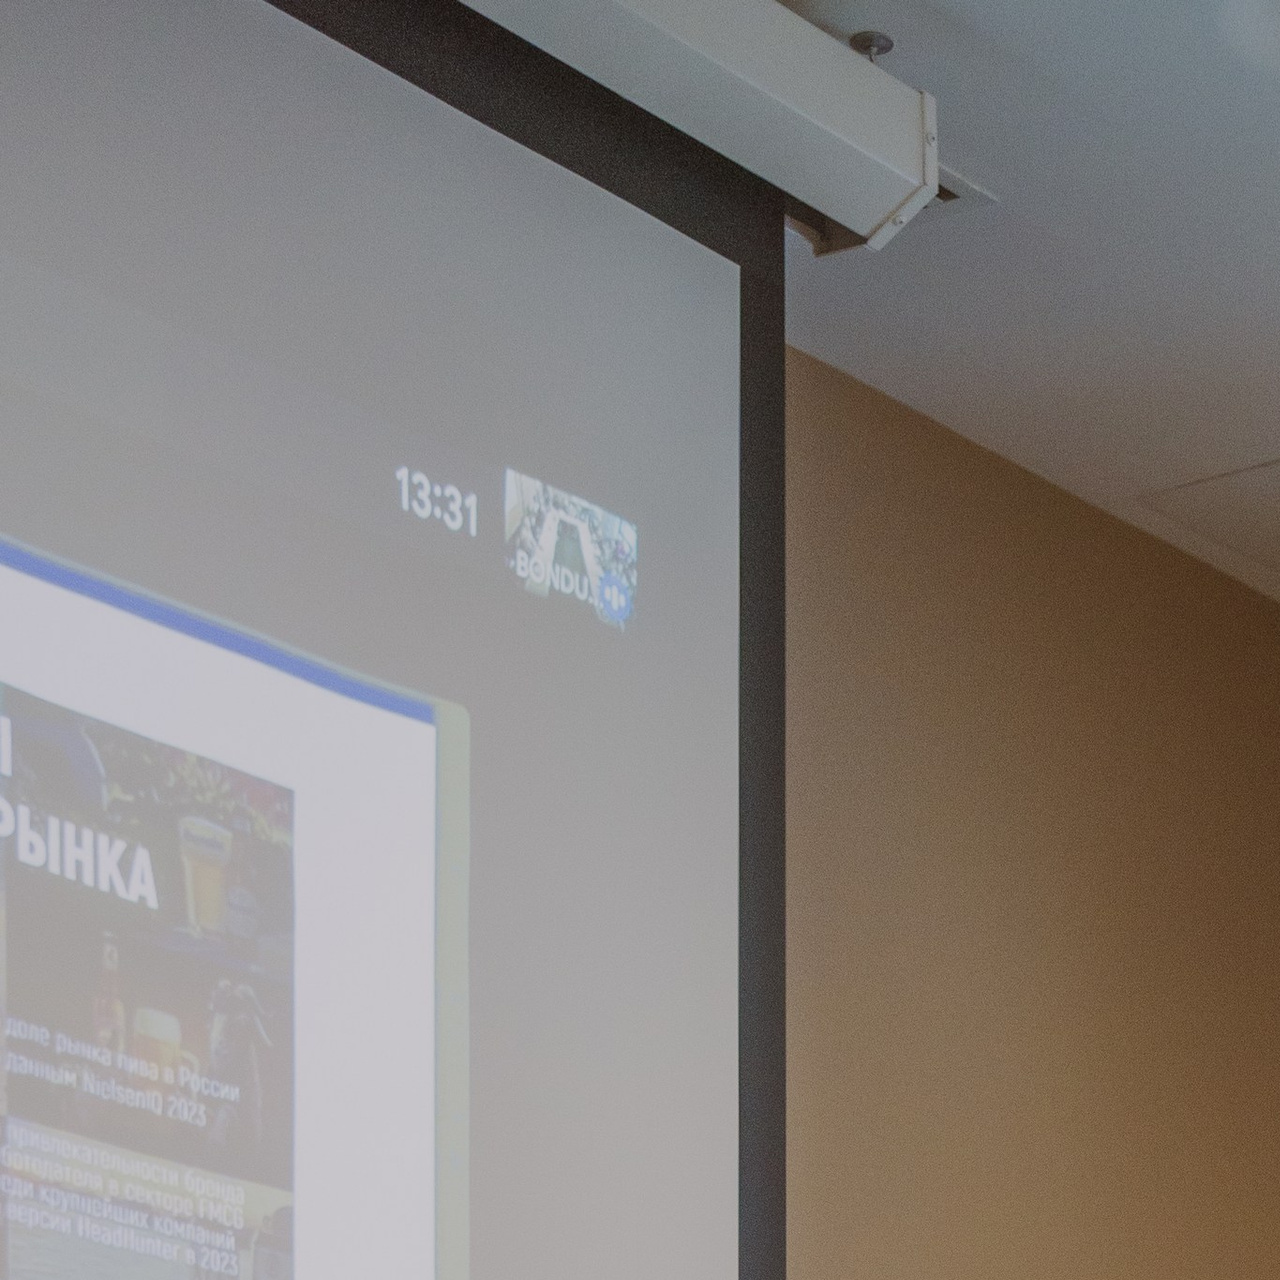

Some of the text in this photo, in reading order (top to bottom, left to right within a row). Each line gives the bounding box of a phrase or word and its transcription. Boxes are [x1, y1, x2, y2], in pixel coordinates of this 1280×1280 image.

[394, 465, 478, 537] 13:31
[179, 1066, 241, 1102] России
[167, 1095, 207, 1127] 2023
[200, 1246, 239, 1277] 2023
